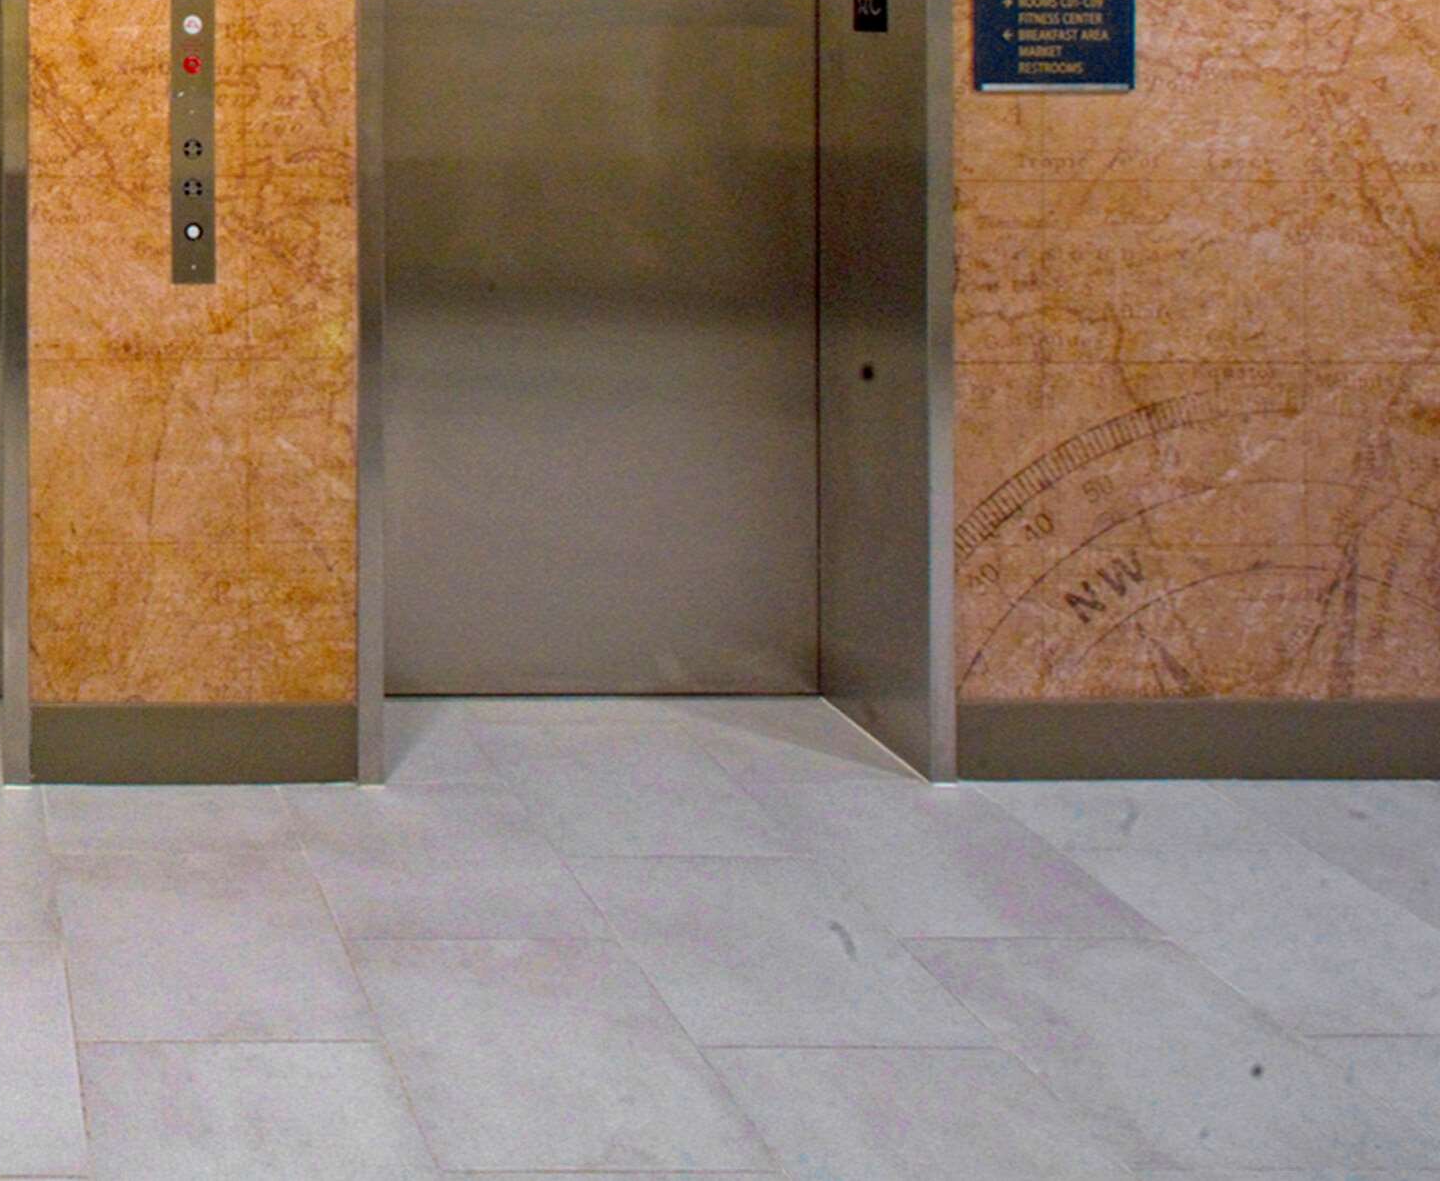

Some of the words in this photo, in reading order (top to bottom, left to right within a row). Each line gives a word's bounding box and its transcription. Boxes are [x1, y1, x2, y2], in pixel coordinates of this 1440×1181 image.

[1018, 12, 1060, 25] FITNESS
[1062, 12, 1103, 25] CENTER
[1018, 28, 1078, 41] BREAKFAST
[1081, 28, 1109, 41] AREA
[1018, 45, 1062, 57] MARKET
[1018, 61, 1084, 75] RESTROOMS
[1064, 549, 1145, 624] NW
